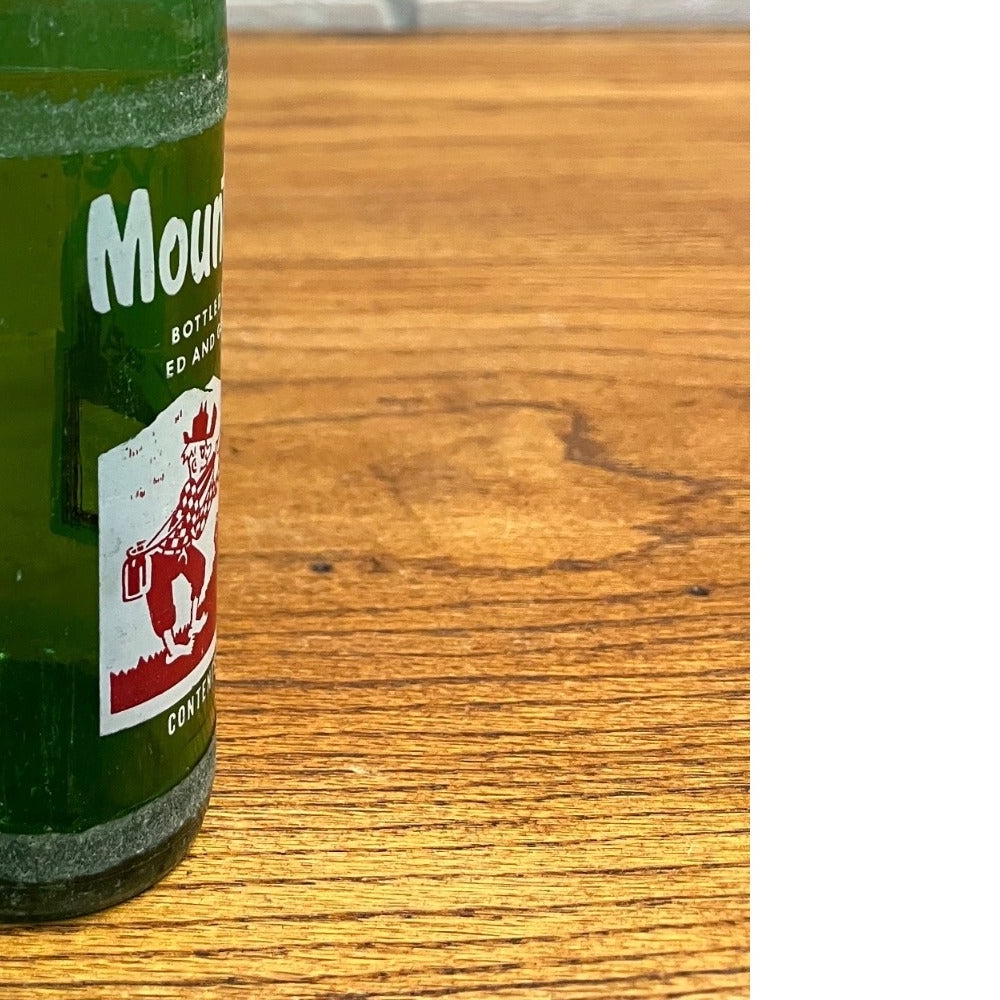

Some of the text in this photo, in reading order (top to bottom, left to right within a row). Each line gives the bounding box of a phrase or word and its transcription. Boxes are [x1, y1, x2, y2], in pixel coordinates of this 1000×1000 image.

[86, 176, 224, 314] Moun
[166, 333, 215, 379] ED AND
[168, 662, 214, 736] CONTEN
